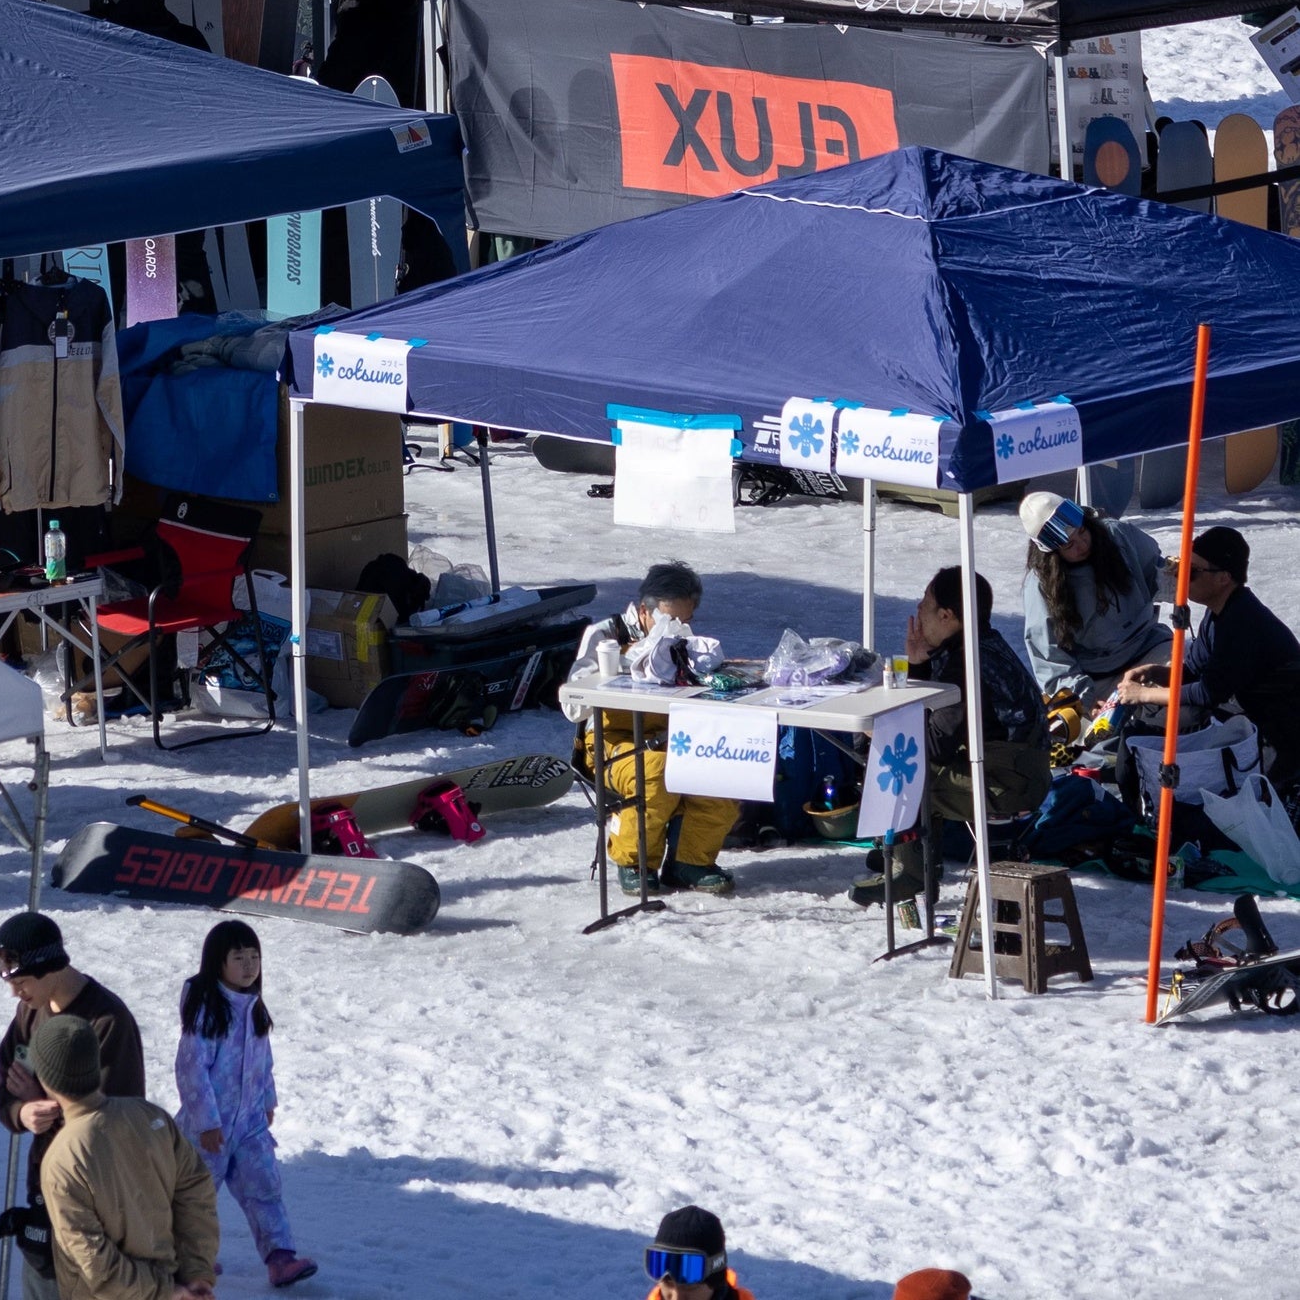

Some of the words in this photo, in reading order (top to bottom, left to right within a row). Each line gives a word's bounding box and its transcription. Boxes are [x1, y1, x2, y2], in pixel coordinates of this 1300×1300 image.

[145, 238, 157, 278] OARDS
[338, 358, 404, 385] cotsume
[380, 359, 404, 367] コツミー
[753, 443, 781, 455] Powere
[863, 436, 934, 464] cotsume
[909, 437, 936, 447] コツミー
[1018, 425, 1080, 455] cotsume
[813, 472, 837, 495] LUX
[695, 735, 772, 763] cotsume
[746, 737, 773, 746] コツミー
[532, 759, 569, 788] MIND
[115, 844, 380, 914] TECHNOLOGIES
